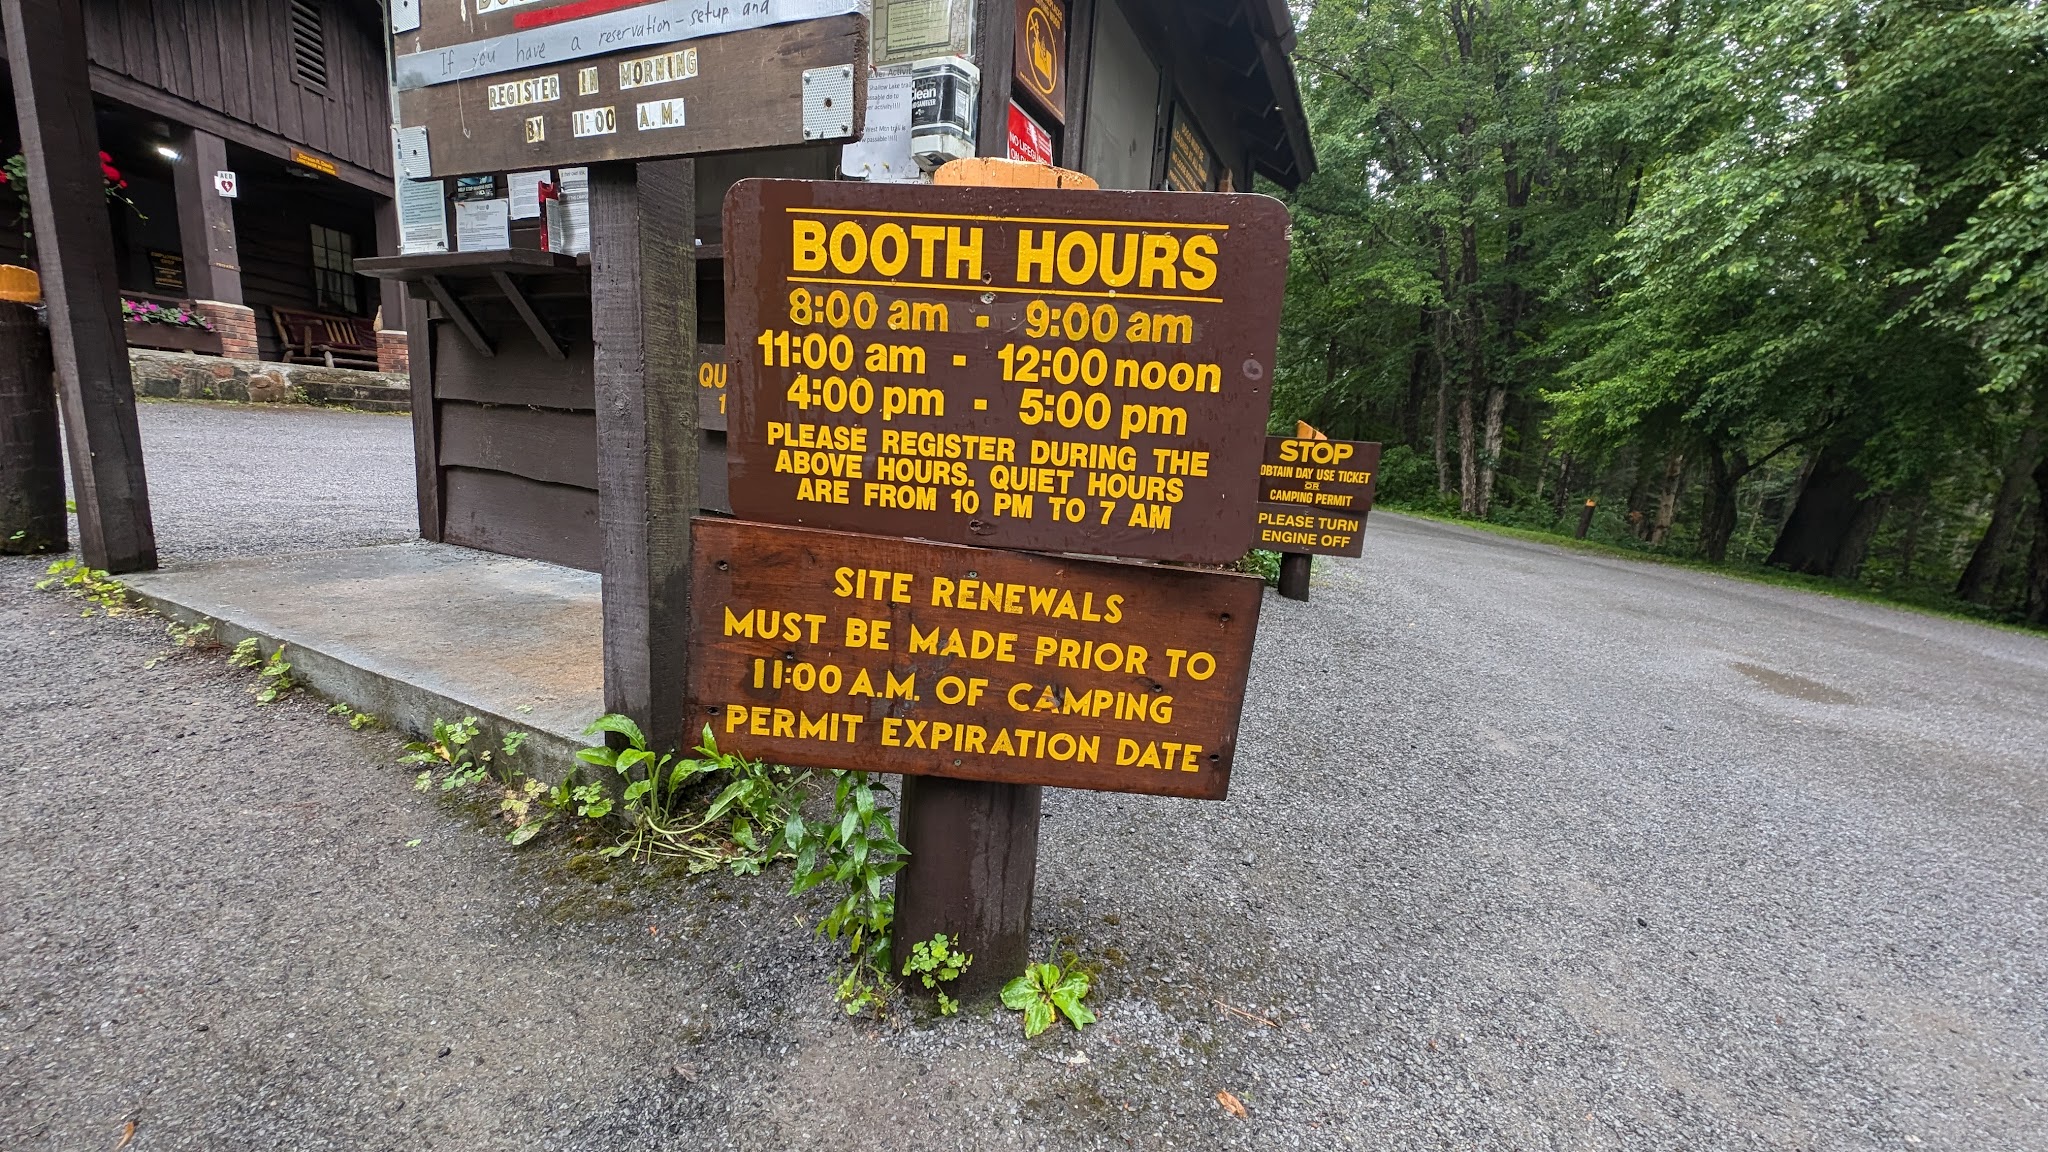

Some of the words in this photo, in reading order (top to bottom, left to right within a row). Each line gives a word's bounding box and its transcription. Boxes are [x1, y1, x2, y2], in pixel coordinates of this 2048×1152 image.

[439, 49, 455, 76] If
[472, 50, 496, 70] you
[516, 38, 546, 63] have
[571, 36, 581, 51] a
[598, 15, 671, 47] reservation
[690, 6, 729, 27] setup
[742, 0, 769, 16] and
[488, 76, 559, 108] REGISTER
[581, 69, 598, 93] IN
[620, 50, 697, 87] MORNING
[526, 118, 543, 141] BY
[573, 108, 615, 134] 11:00
[1010, 131, 1019, 146] NO
[793, 220, 983, 280] BOOTH
[1017, 230, 1218, 290] HOURS
[789, 288, 878, 329] 8:00
[887, 300, 948, 332] am
[1026, 300, 1118, 342] 9:00
[1126, 311, 1192, 343] am
[699, 363, 727, 388] QU
[758, 330, 853, 371] 11:00
[865, 343, 925, 374] am
[998, 344, 1108, 386] 12:00
[1115, 359, 1221, 392] noon
[787, 374, 874, 414] 4:00
[883, 387, 944, 420] pm
[1019, 388, 1111, 430] 5:00
[1121, 405, 1187, 439] pm
[768, 422, 867, 452] PLEASE
[882, 430, 1015, 462] REGISTER
[1031, 440, 1136, 471] DURING
[1153, 449, 1209, 477] THE
[775, 450, 862, 478] ABOVE
[878, 457, 974, 487] HOURS.
[990, 465, 1074, 494] QUIET
[1088, 472, 1183, 502] HOURS
[1260, 464, 1293, 478] OBTAIN
[1295, 467, 1314, 480] DAY
[1317, 469, 1335, 481] USE
[1338, 470, 1371, 484] TICKET
[1279, 440, 1354, 465] STOP
[797, 478, 849, 504] ARE
[864, 483, 936, 511] FROM
[951, 489, 979, 514] 10
[994, 492, 1033, 518] PM
[1049, 497, 1085, 522] TO
[1100, 501, 1115, 524] 7
[1129, 503, 1172, 529] AM
[1269, 489, 1313, 504] CAMPING
[1315, 493, 1353, 507] PERMIT
[1304, 482, 1320, 490] OR
[1258, 512, 1314, 528] PLEASE
[1318, 517, 1359, 532] TURN
[1261, 529, 1317, 545] ENGINE
[1321, 535, 1351, 548] OFF
[833, 567, 913, 603] SITE
[931, 577, 1124, 623] RENEWALS
[725, 607, 826, 644] MUST
[845, 618, 891, 650] BE
[909, 624, 1018, 662] MADE
[1035, 636, 1148, 674] PRIOR
[1166, 649, 1216, 680] TO
[754, 659, 842, 694] 11:00
[848, 668, 919, 702] A.M.
[936, 676, 988, 706] OF
[1008, 683, 1173, 724] CAMPING
[726, 705, 863, 742] PERMIT
[882, 718, 1100, 763] EXPIRATION
[1116, 738, 1202, 772] DATE
